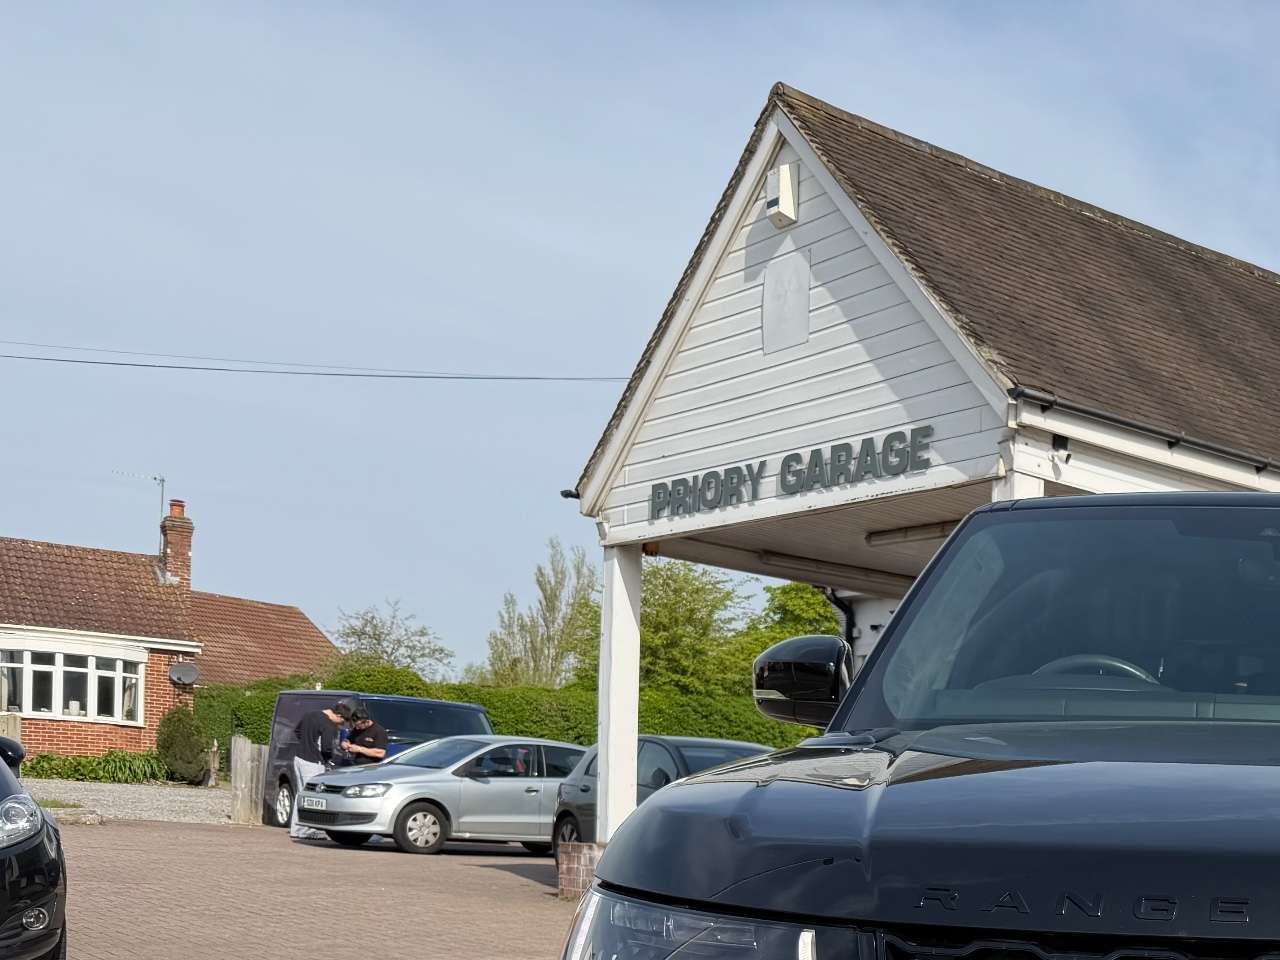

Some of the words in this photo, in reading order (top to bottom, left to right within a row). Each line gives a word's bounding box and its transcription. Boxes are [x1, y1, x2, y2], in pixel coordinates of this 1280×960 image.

[650, 460, 767, 520] PRIORY
[780, 425, 935, 495] GARAGE
[913, 887, 1250, 922] RANGE
